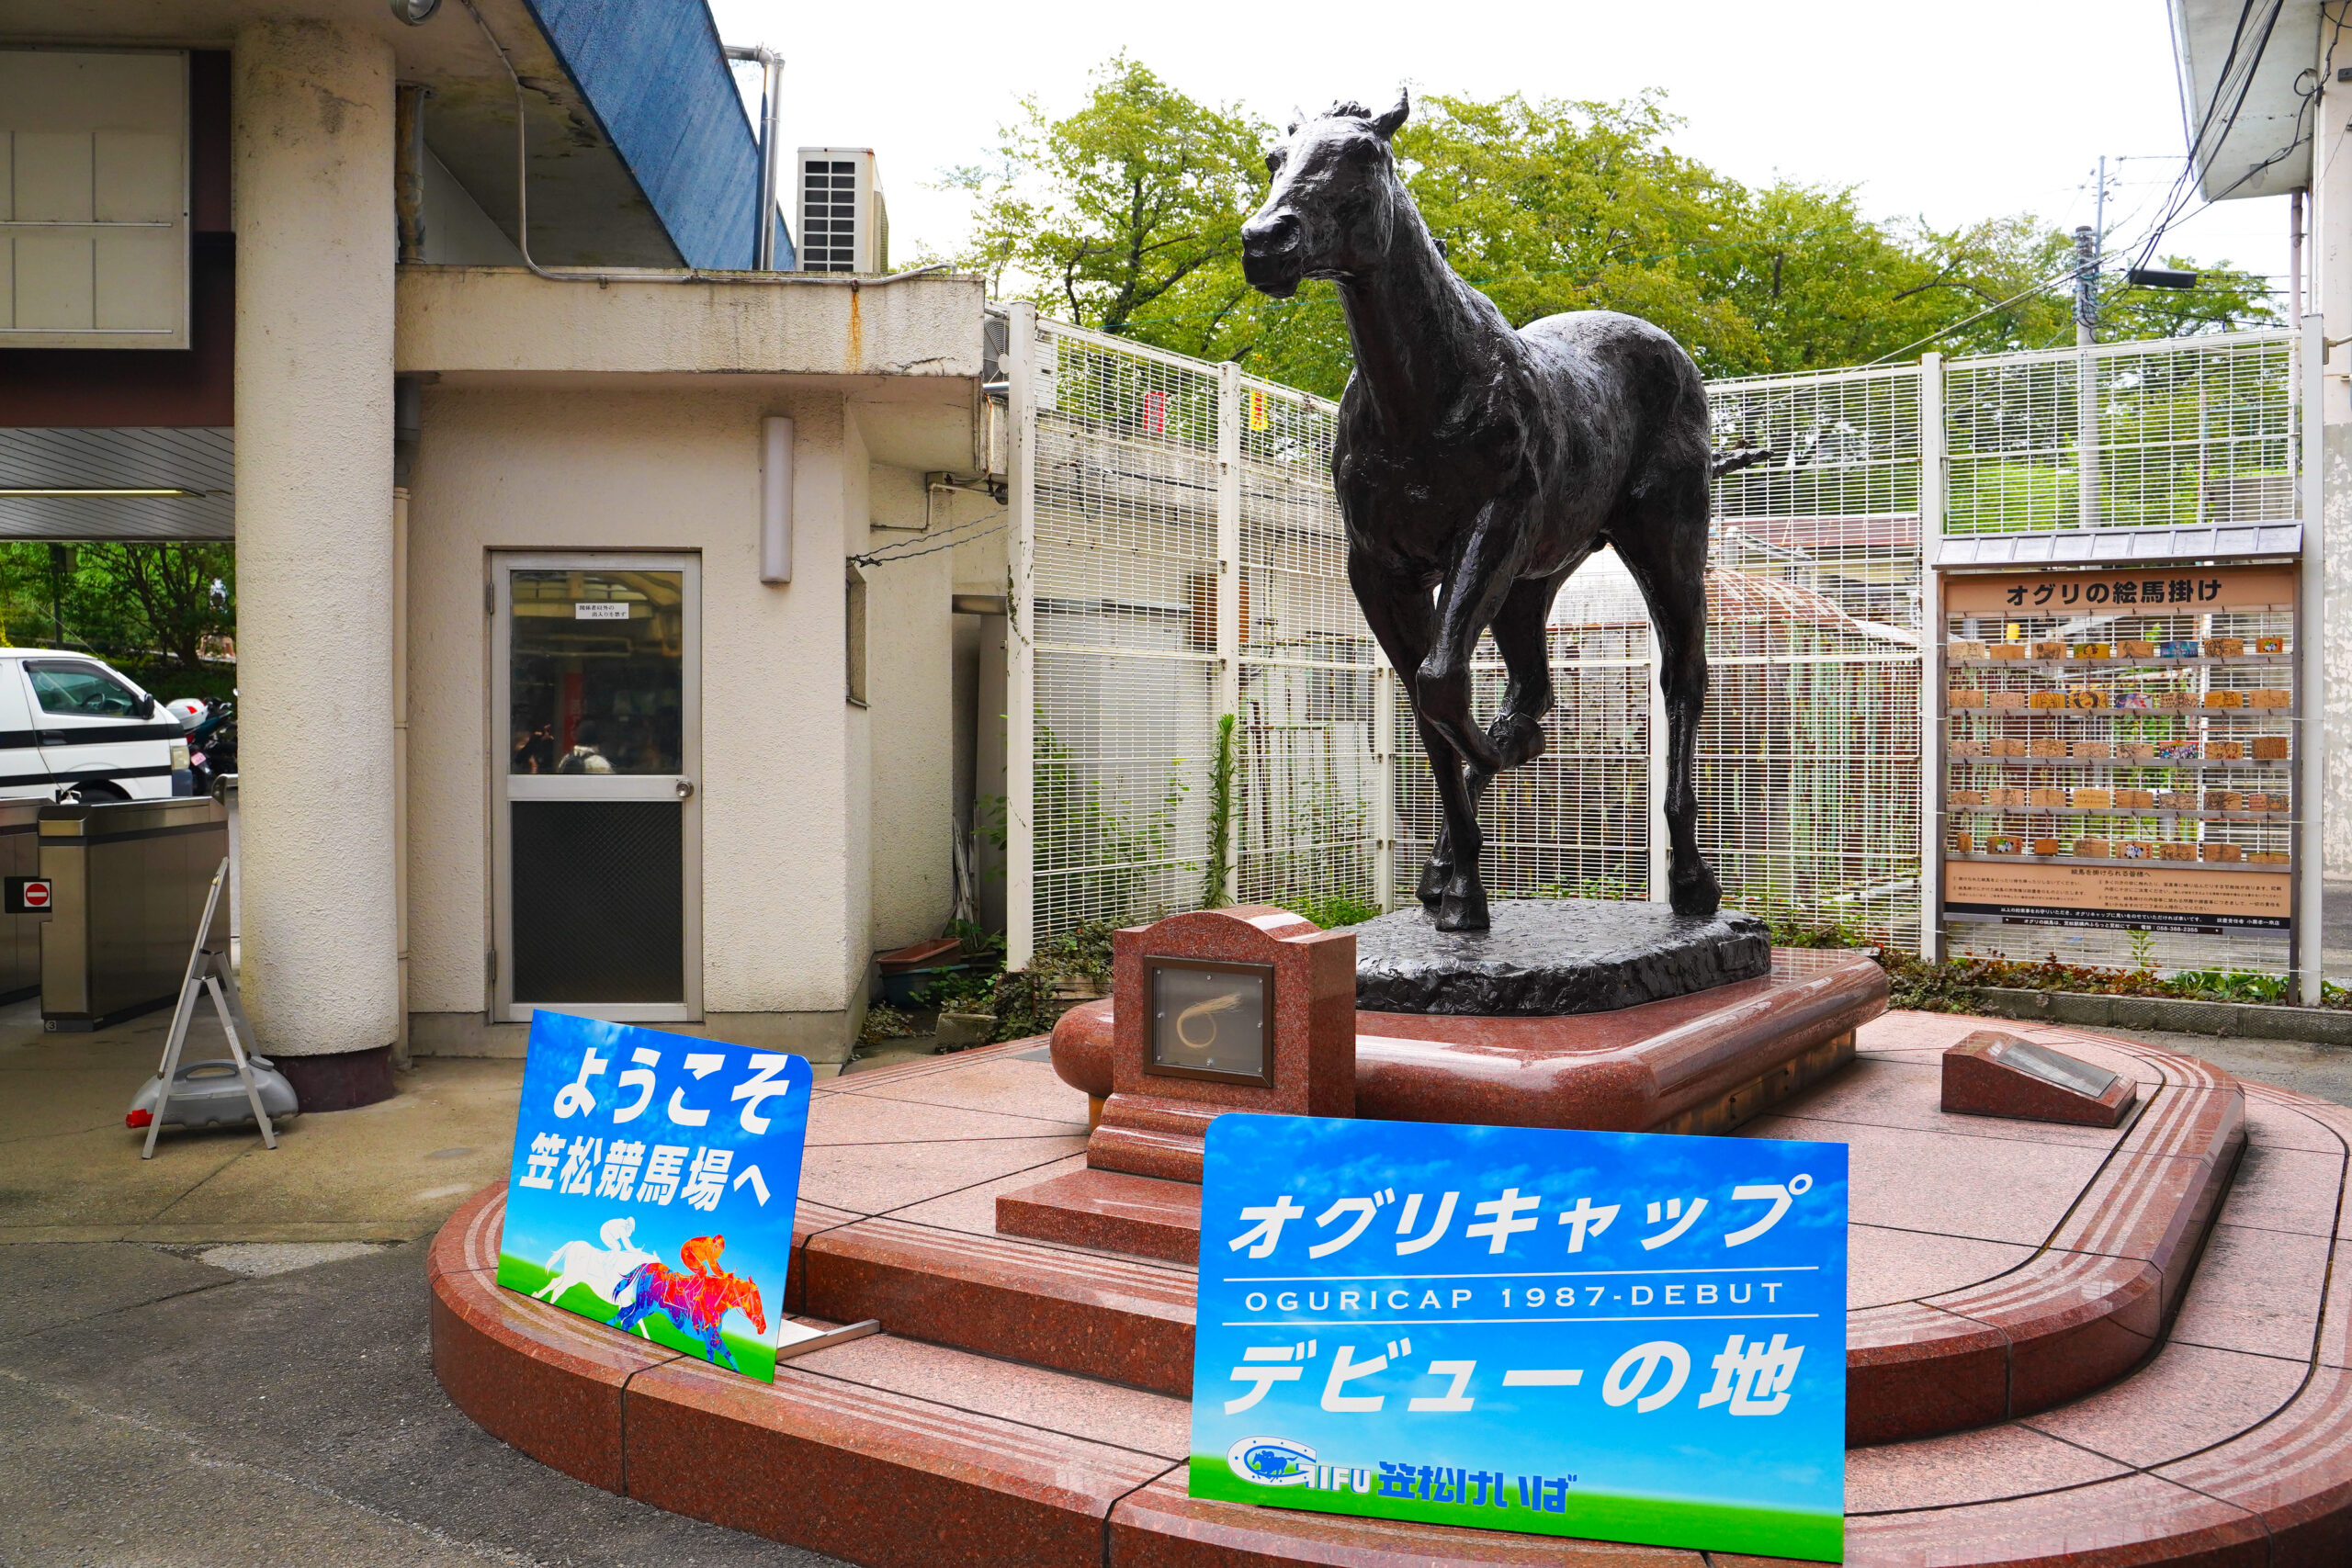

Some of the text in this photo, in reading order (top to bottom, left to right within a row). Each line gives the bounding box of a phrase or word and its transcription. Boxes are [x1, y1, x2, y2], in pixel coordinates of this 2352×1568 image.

[2007, 580, 2222, 606] オグリの絵馬掛け
[553, 1047, 790, 1135] ようこそ
[519, 1132, 771, 1212] 笠松競馬場へ
[1227, 1173, 1814, 1259] オグリキャップ
[1245, 1282, 1784, 1312] OGURICAP 1987-DEBUT
[1224, 1334, 1805, 1416] デビューの地
[1378, 1461, 1577, 1514] 笠松けいば
